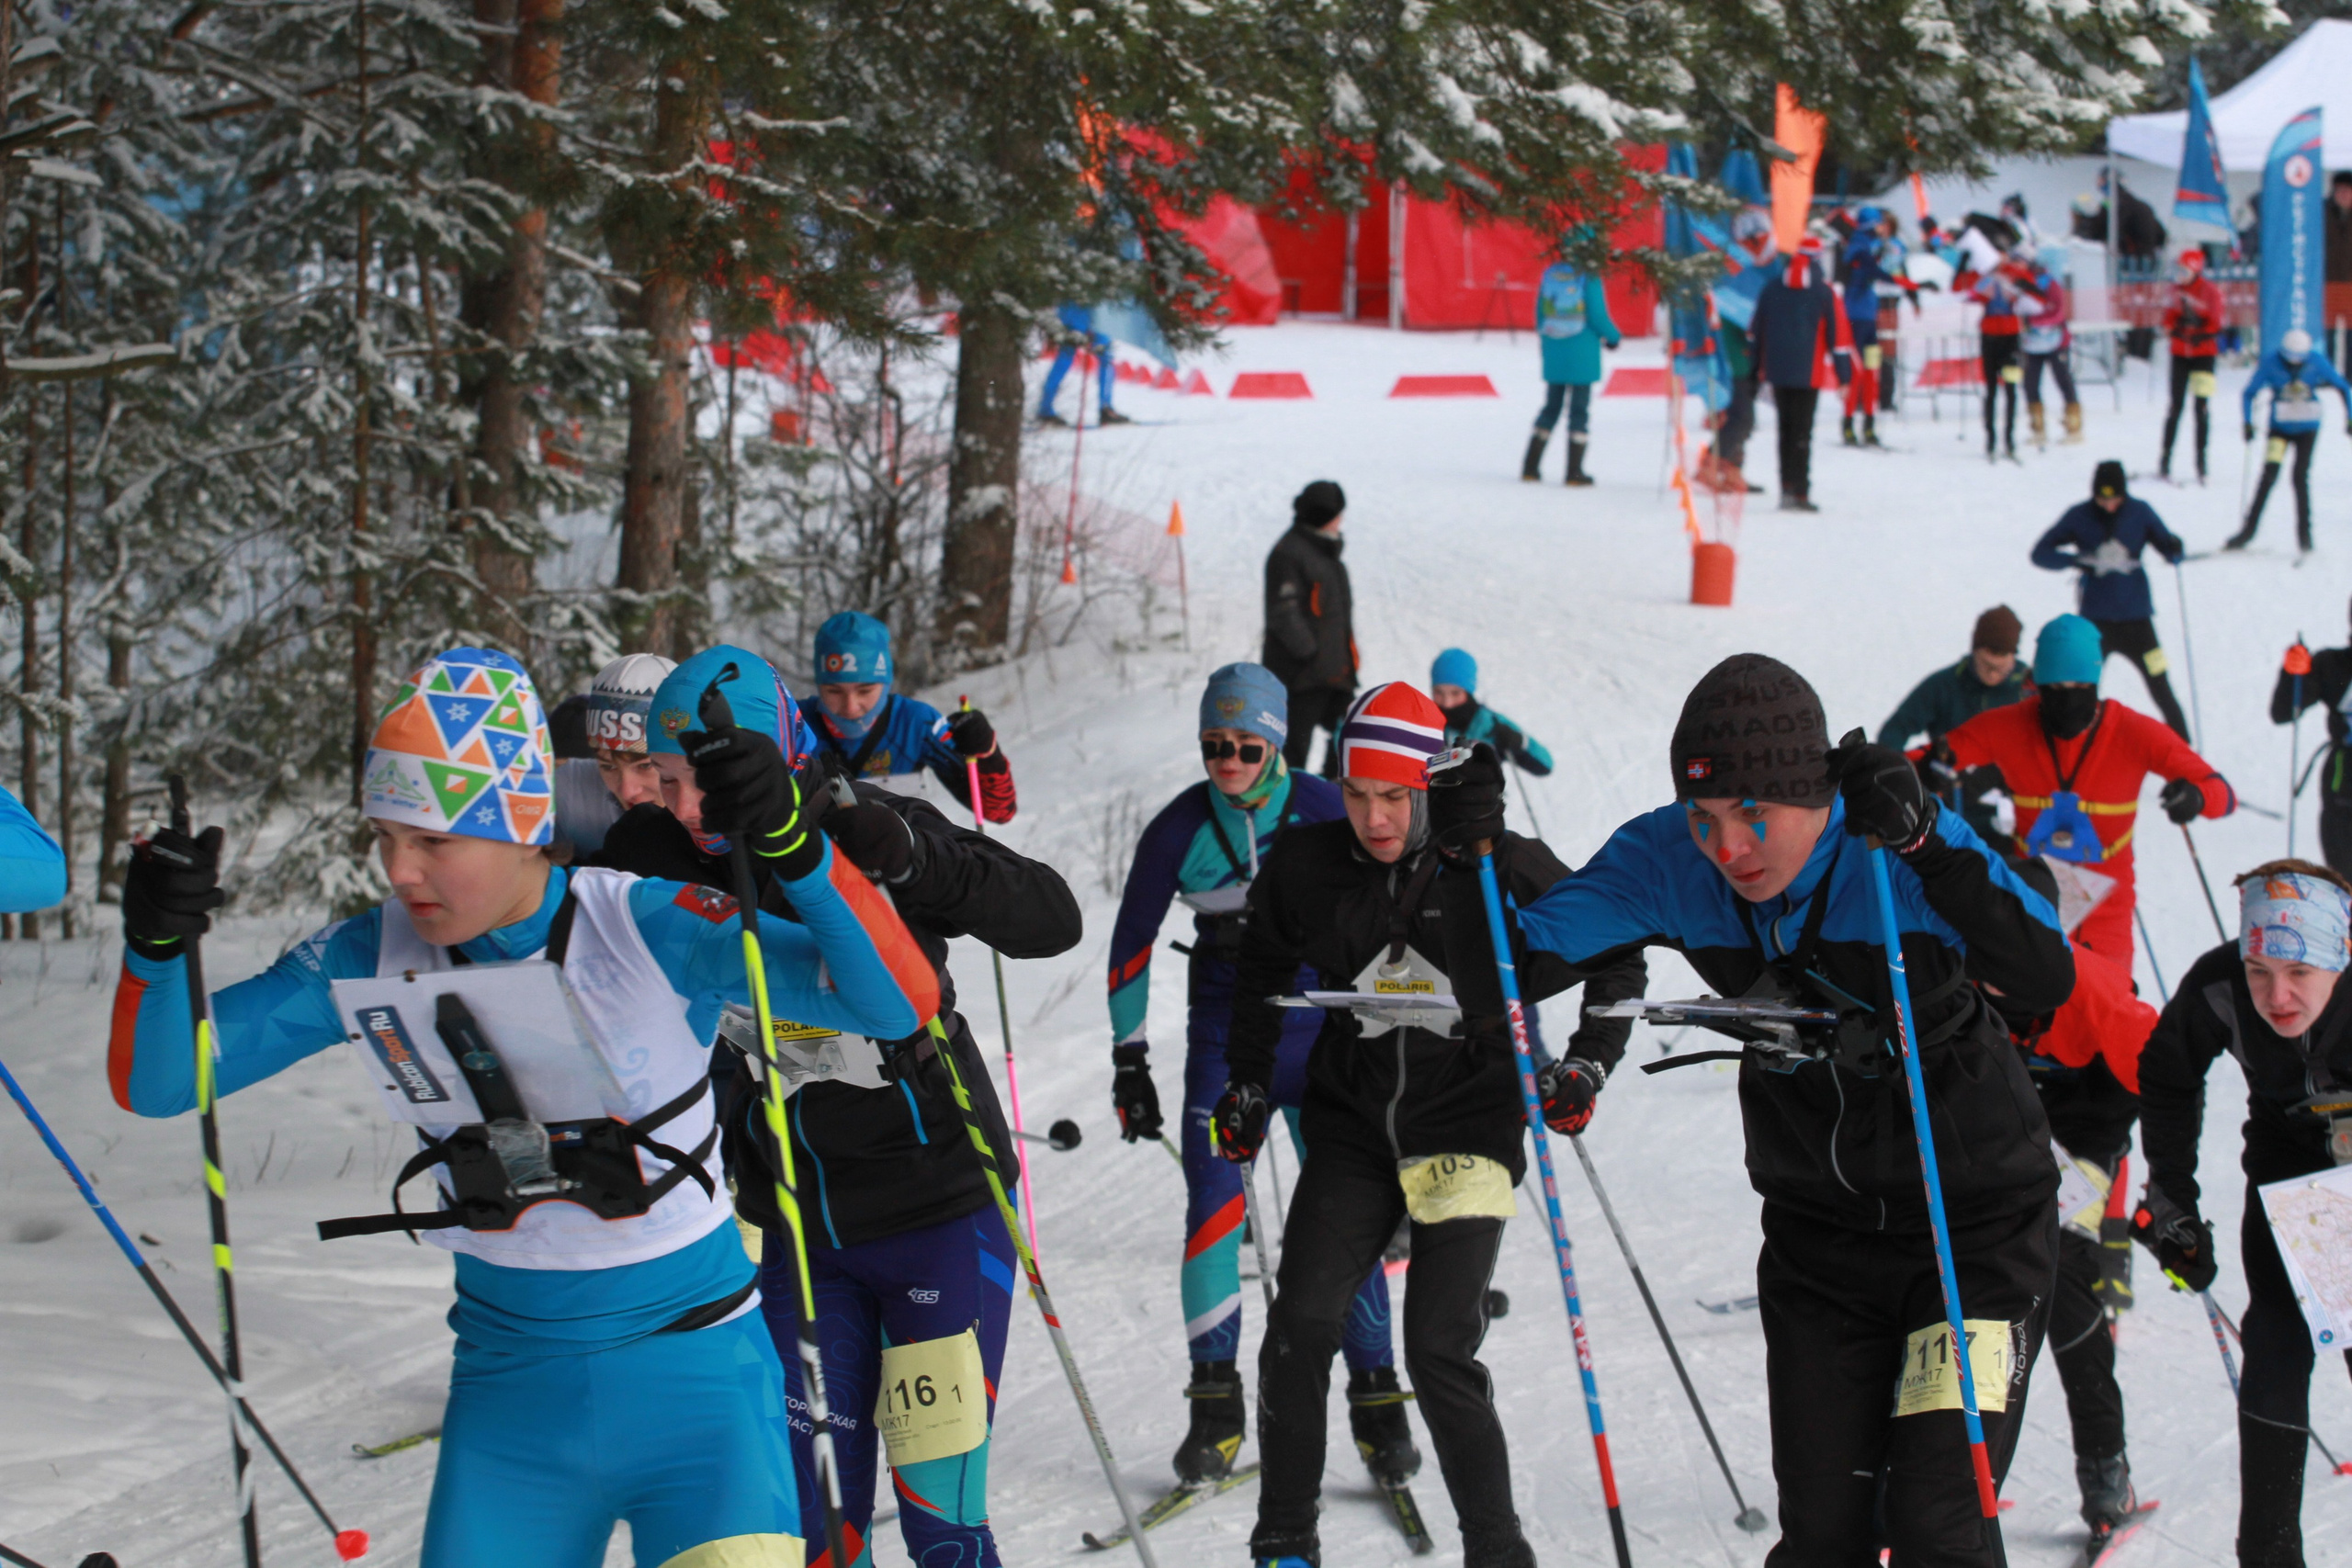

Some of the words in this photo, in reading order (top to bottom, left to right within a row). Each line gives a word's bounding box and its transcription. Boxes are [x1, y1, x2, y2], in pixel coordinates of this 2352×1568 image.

[586, 709, 648, 741] USS
[1993, 1348, 2002, 1369] 1
[886, 1374, 937, 1414] 116
[951, 1383, 962, 1404] 1
